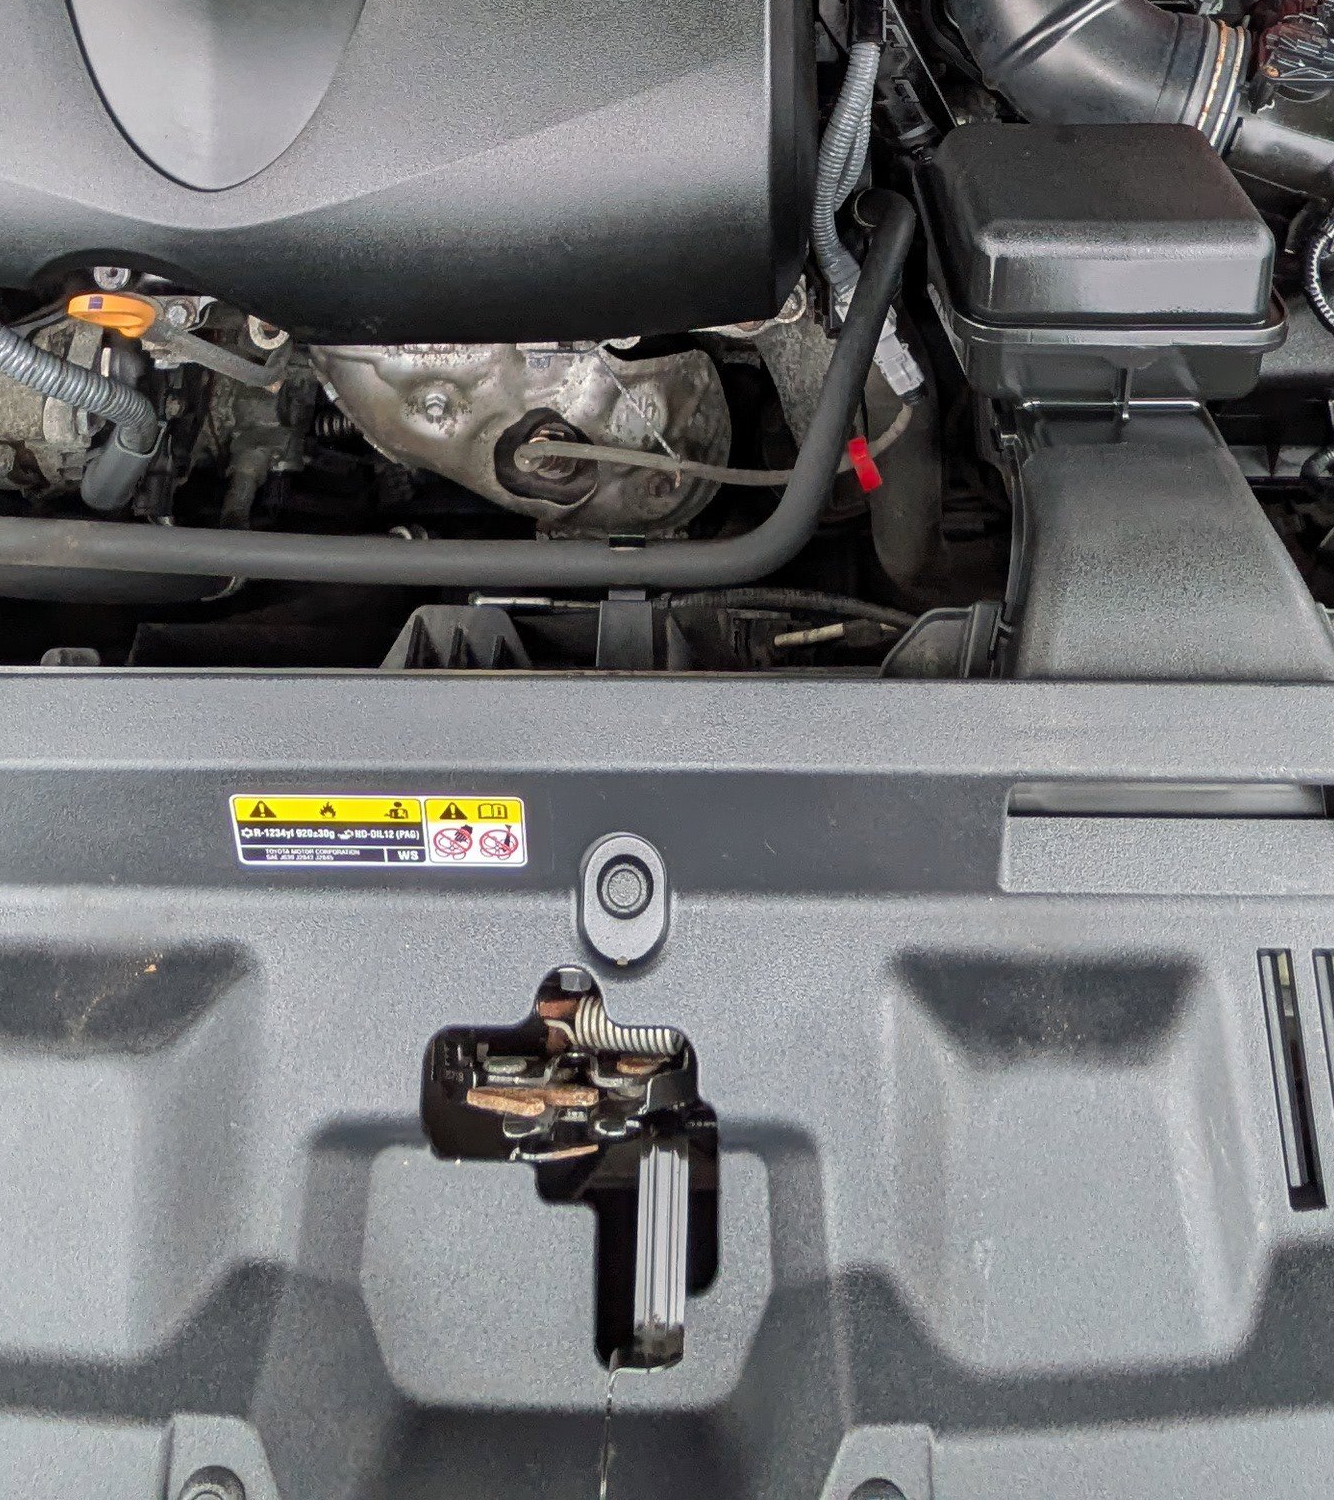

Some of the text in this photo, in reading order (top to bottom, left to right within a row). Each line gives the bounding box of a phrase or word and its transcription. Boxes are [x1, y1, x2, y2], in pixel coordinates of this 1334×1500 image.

[253, 828, 294, 840] R-1234yf
[265, 848, 361, 856] TOYOTA MOTOR CORPORATION
[397, 850, 419, 861] WS
